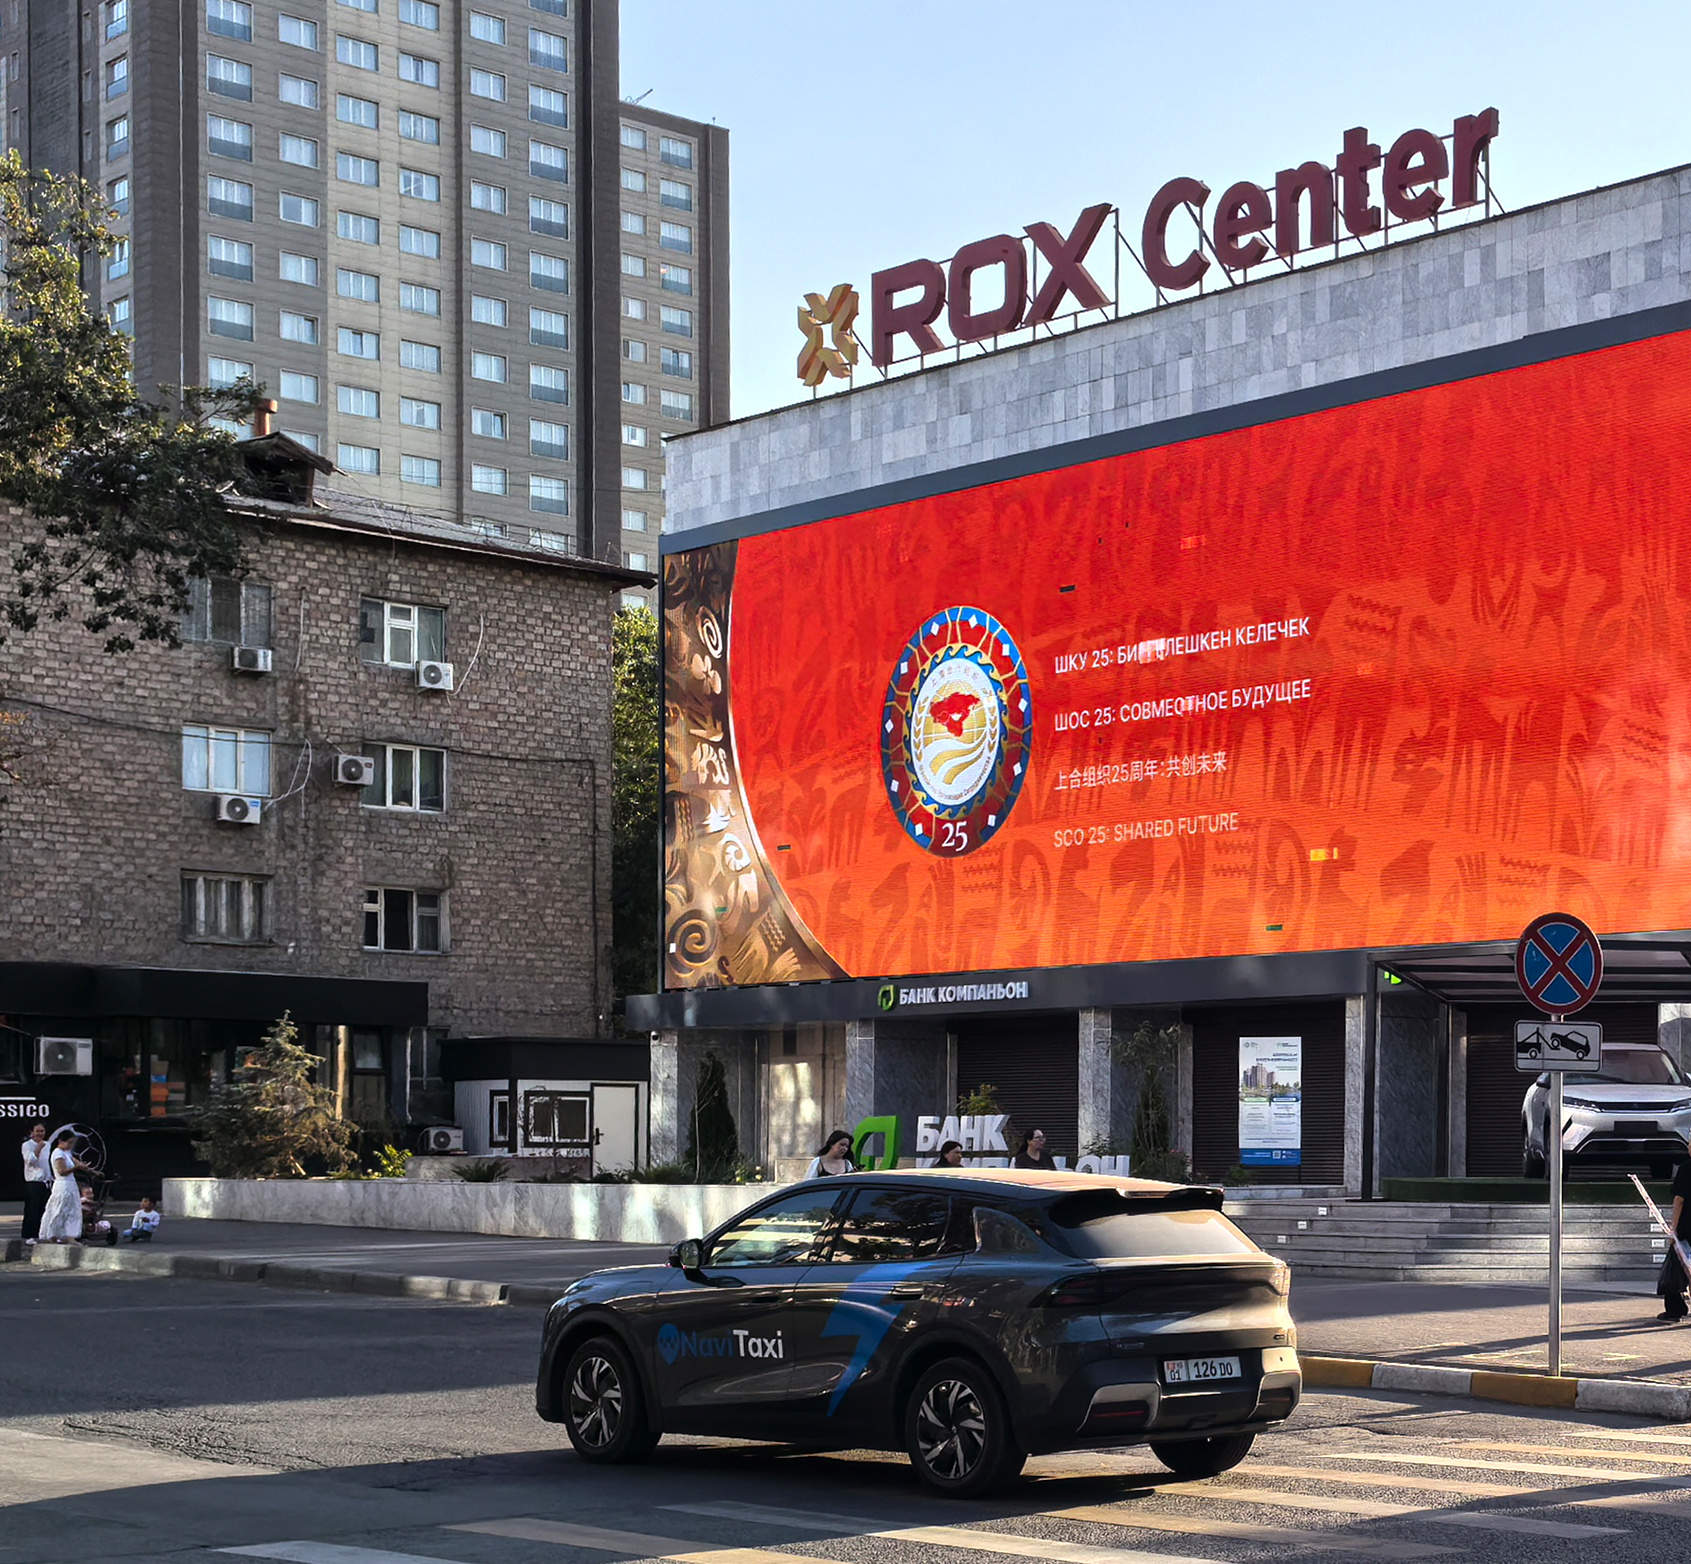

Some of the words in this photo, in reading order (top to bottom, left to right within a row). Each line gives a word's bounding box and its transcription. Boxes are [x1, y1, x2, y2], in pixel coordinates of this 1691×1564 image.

[871, 203, 1112, 367] ROX
[1142, 106, 1499, 290] Center
[1055, 651, 1087, 674] ШКУ
[1092, 648, 1114, 667] 25:
[1118, 630, 1232, 664] БИЛЕШКЕН
[1236, 617, 1310, 645] КЕЛЕЧЕК
[1055, 709, 1091, 731] ШОС
[1094, 706, 1116, 726] 25:
[1232, 679, 1311, 709] БУДУЩЕЕ
[941, 821, 968, 852] 25
[1053, 829, 1085, 848] SCO
[1088, 826, 1111, 845] 25:
[1114, 818, 1175, 842] SHARED
[1178, 812, 1240, 835] FUTURE
[900, 988, 936, 1006] БАНК
[938, 981, 1029, 1002] КОМПАНЬОН
[916, 1114, 1010, 1152] БАНК
[1194, 1360, 1217, 1378] 126
